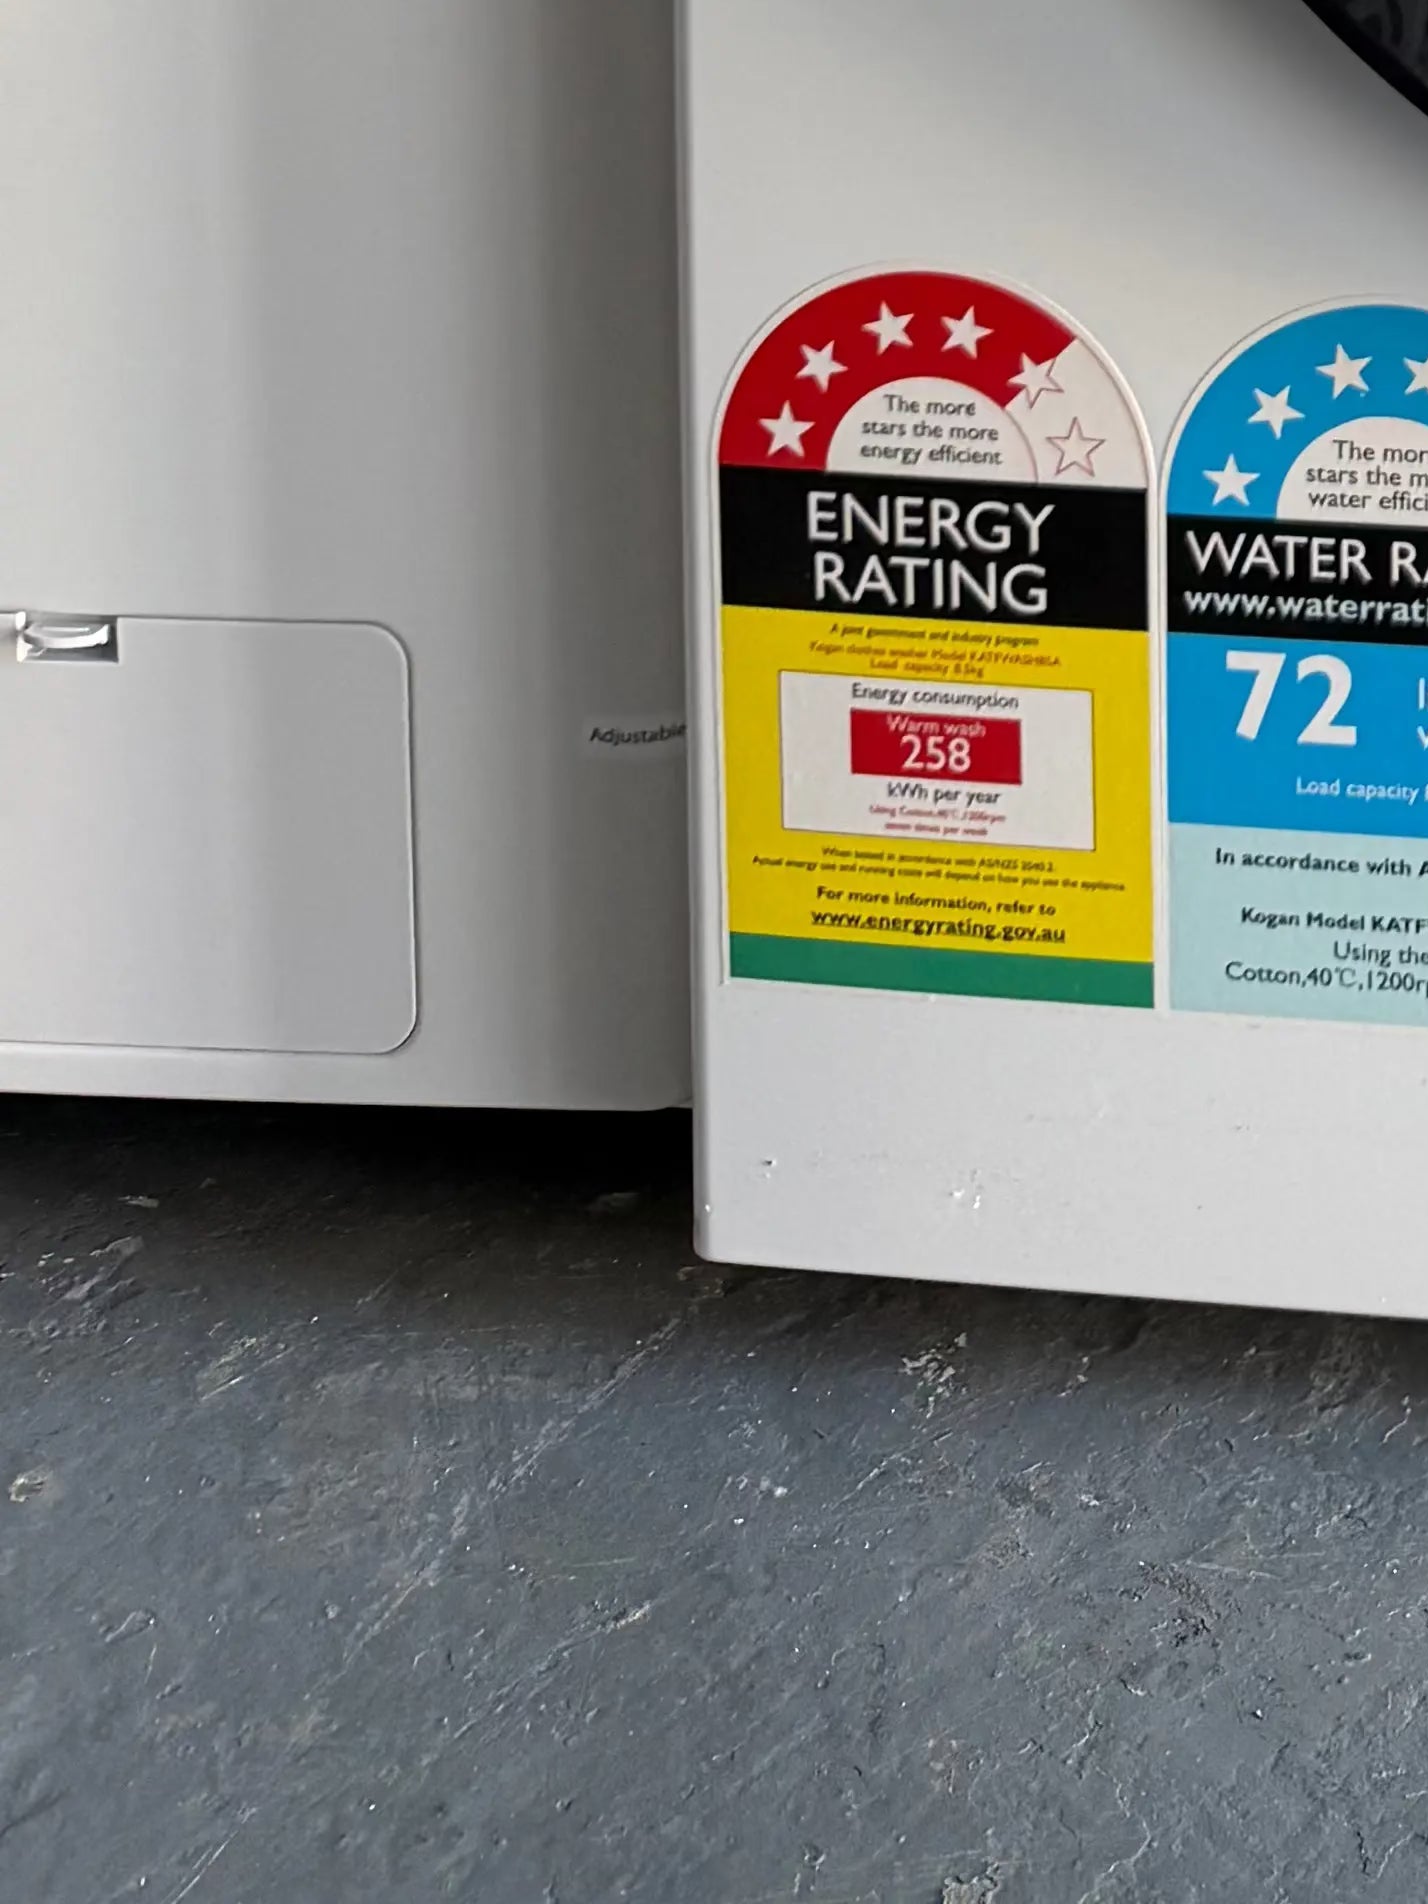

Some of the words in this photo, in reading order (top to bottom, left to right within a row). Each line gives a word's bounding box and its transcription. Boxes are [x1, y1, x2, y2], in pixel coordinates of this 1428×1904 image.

[883, 394, 920, 415] The
[926, 399, 976, 417] more
[862, 422, 907, 437] stars
[912, 422, 944, 439] the
[950, 425, 998, 441] more
[860, 445, 921, 464] energy
[928, 446, 1003, 465] efficient
[1332, 439, 1376, 462] The
[1306, 466, 1358, 485] stars
[1366, 466, 1401, 487] the
[1308, 492, 1372, 509] water
[806, 491, 1055, 557] ENERGY
[1185, 530, 1373, 584] WATER
[814, 551, 1048, 616] RATING
[852, 682, 908, 705] Energy
[912, 688, 1018, 711] consumption
[1225, 649, 1358, 747] 72
[886, 714, 940, 734] Warm
[944, 721, 986, 737] wash
[900, 734, 971, 773] 258
[933, 788, 961, 805] per
[966, 792, 1002, 805] year
[1296, 776, 1340, 797] Load
[1346, 780, 1419, 805] capacity
[1215, 847, 1235, 865] In
[1241, 851, 1360, 874] accordance
[1366, 857, 1412, 877] with
[816, 886, 843, 901] For
[848, 889, 889, 905] more
[895, 891, 992, 913] information,
[996, 898, 1035, 915] refer
[1039, 902, 1056, 917] to
[811, 909, 1065, 942] www.energyrating.gov.au
[1241, 907, 1300, 929] Kogan
[1306, 911, 1365, 931] Model
[1334, 941, 1392, 967] Using
